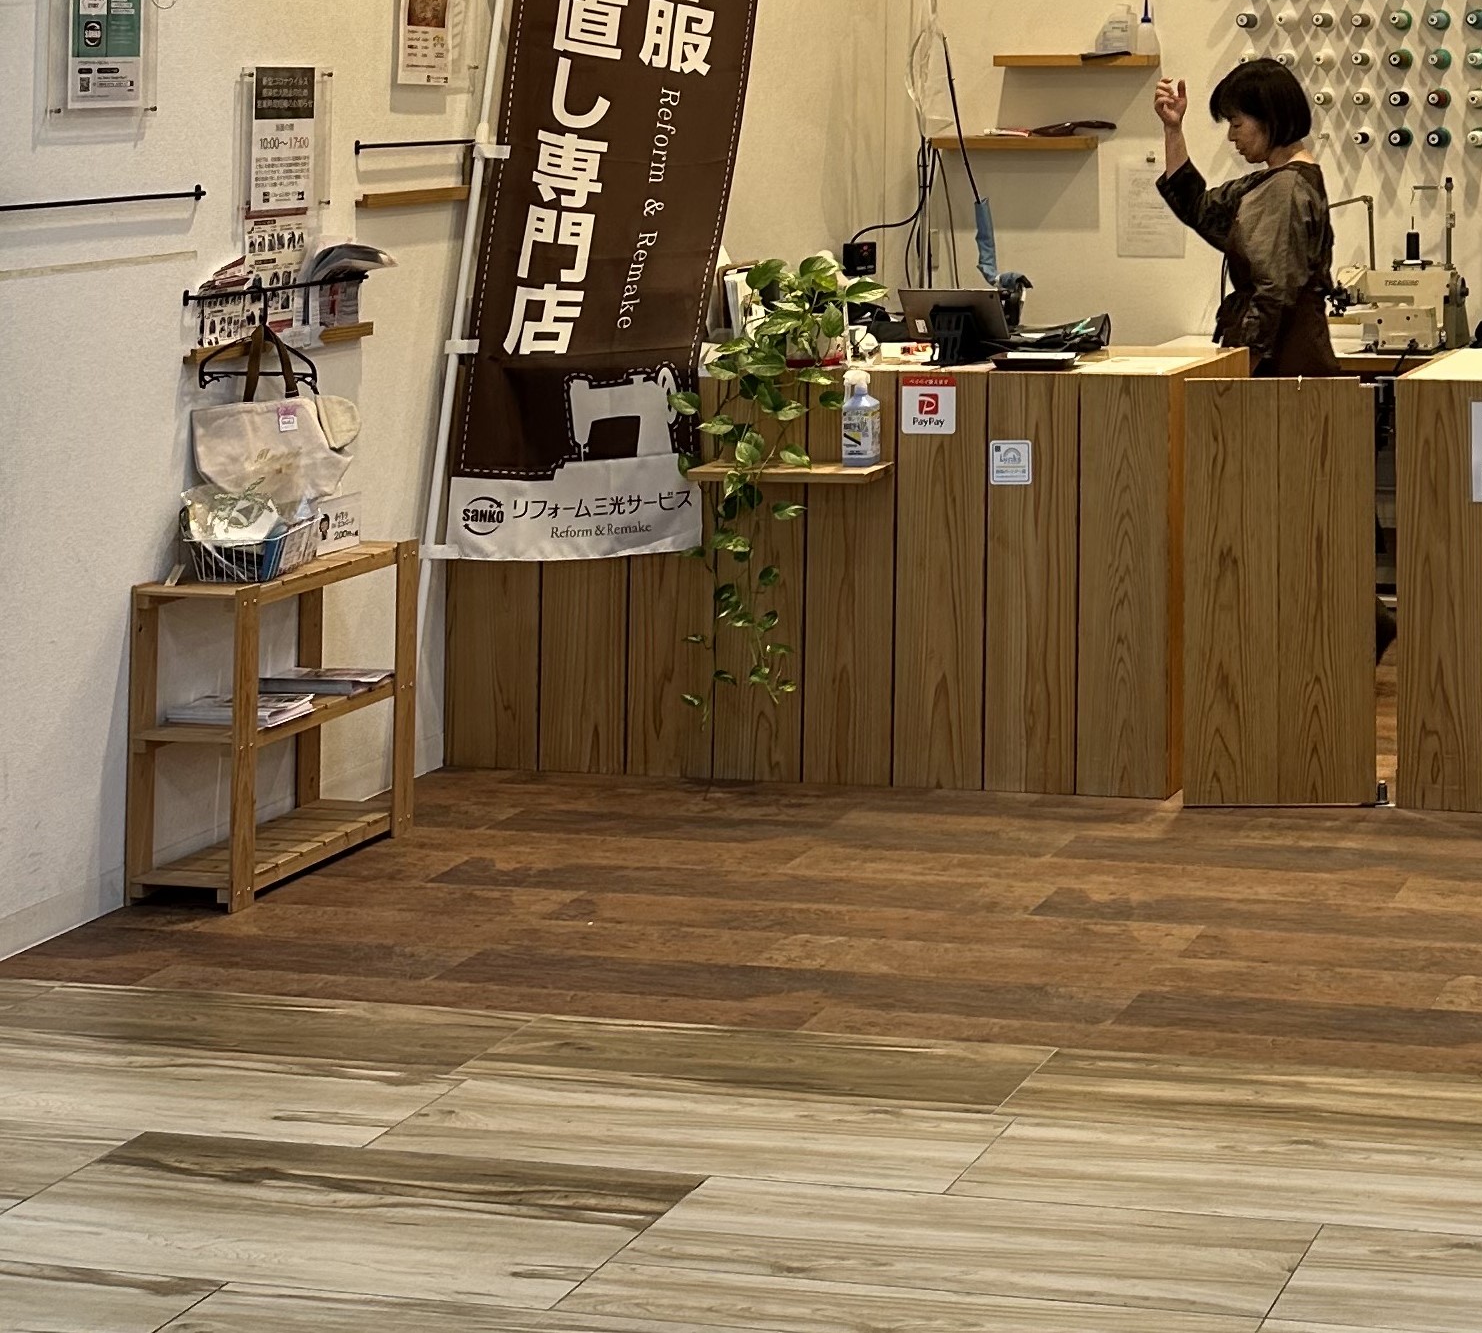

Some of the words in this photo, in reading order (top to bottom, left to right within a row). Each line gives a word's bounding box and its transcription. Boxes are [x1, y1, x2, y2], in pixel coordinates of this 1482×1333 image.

[648, 87, 681, 183] Reform
[643, 198, 665, 216] &
[616, 230, 659, 329] Remake
[912, 417, 944, 427] PayPay
[513, 490, 692, 519] リフォーム三光サービス
[550, 526, 592, 538] Reform
[594, 525, 605, 536] &
[607, 521, 652, 535] Remake
